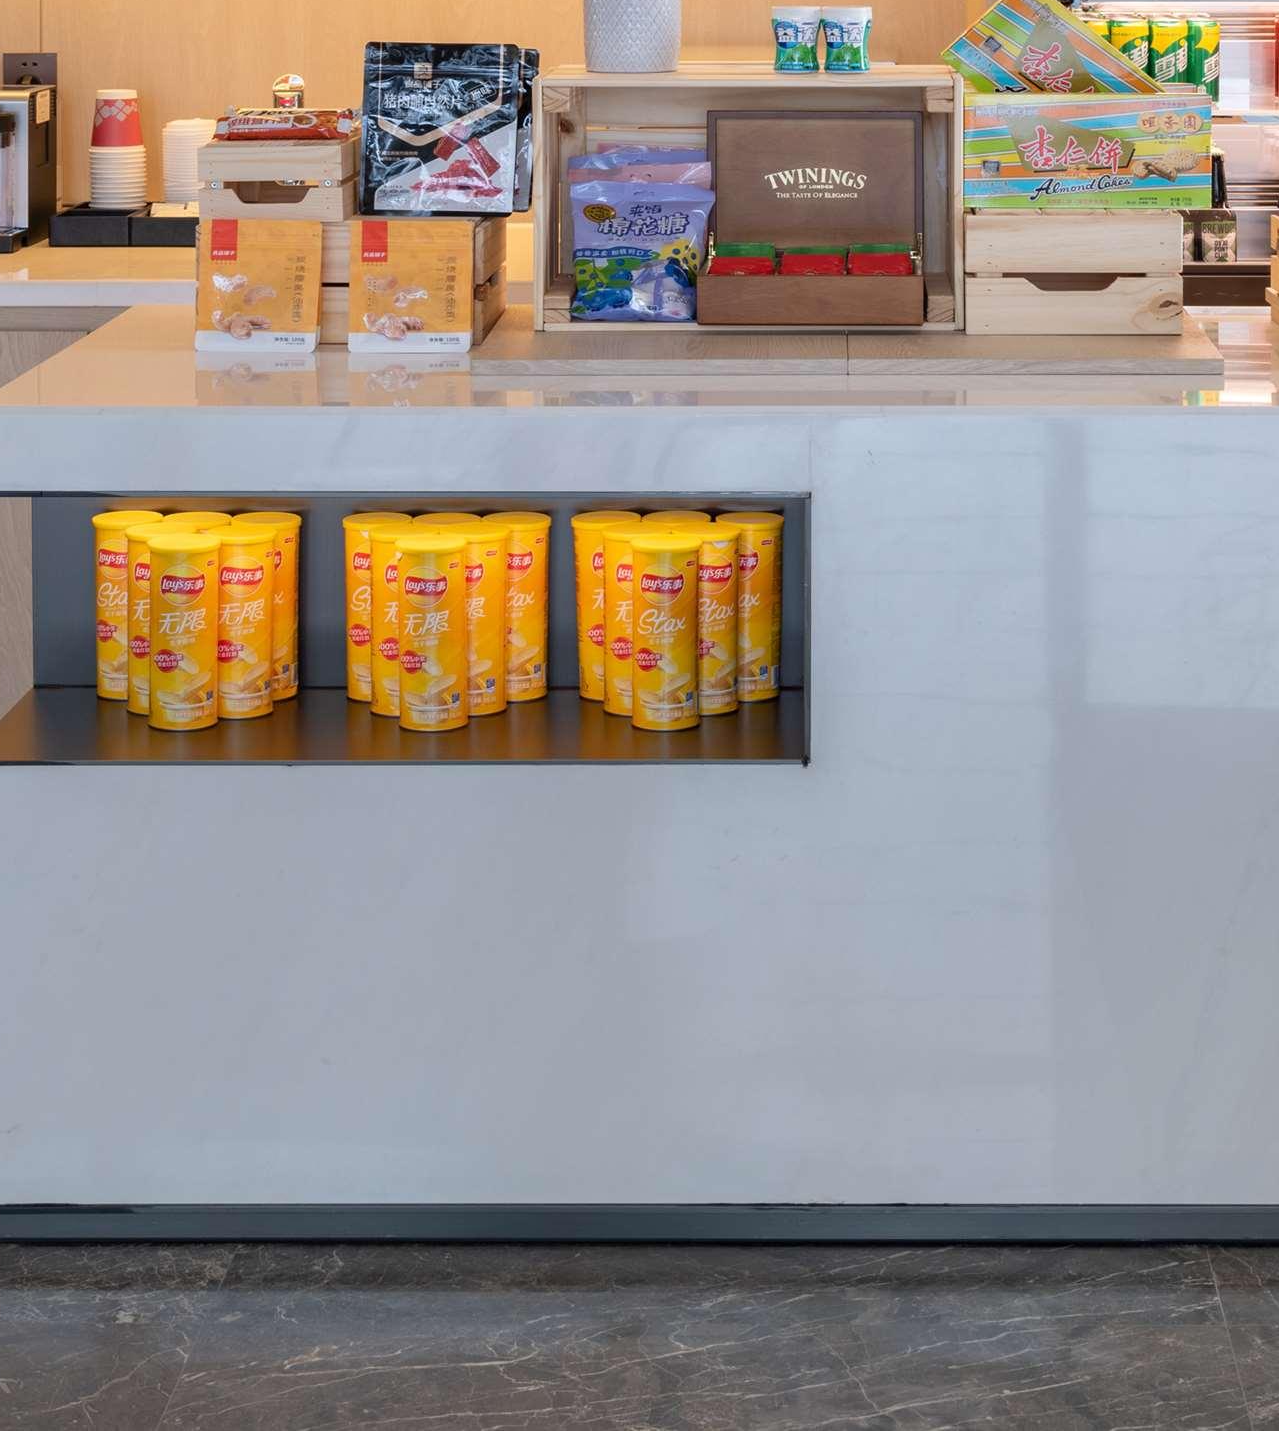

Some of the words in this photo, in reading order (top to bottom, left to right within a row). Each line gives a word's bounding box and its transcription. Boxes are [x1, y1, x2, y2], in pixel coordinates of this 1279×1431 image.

[1153, 39, 1187, 82] 雪碧
[1019, 125, 1124, 174] 杏仁饼
[764, 168, 867, 190] TWININGS
[1029, 178, 1094, 201] Almond
[598, 213, 690, 237] 棉花糖
[162, 579, 187, 591] Lay's
[221, 569, 245, 582] Lay's
[405, 580, 426, 592] Lay's
[641, 576, 662, 590] Lay's
[159, 608, 207, 634] 无限
[219, 598, 265, 626] 无限
[404, 609, 450, 636] 无限
[637, 608, 687, 635] Stax
